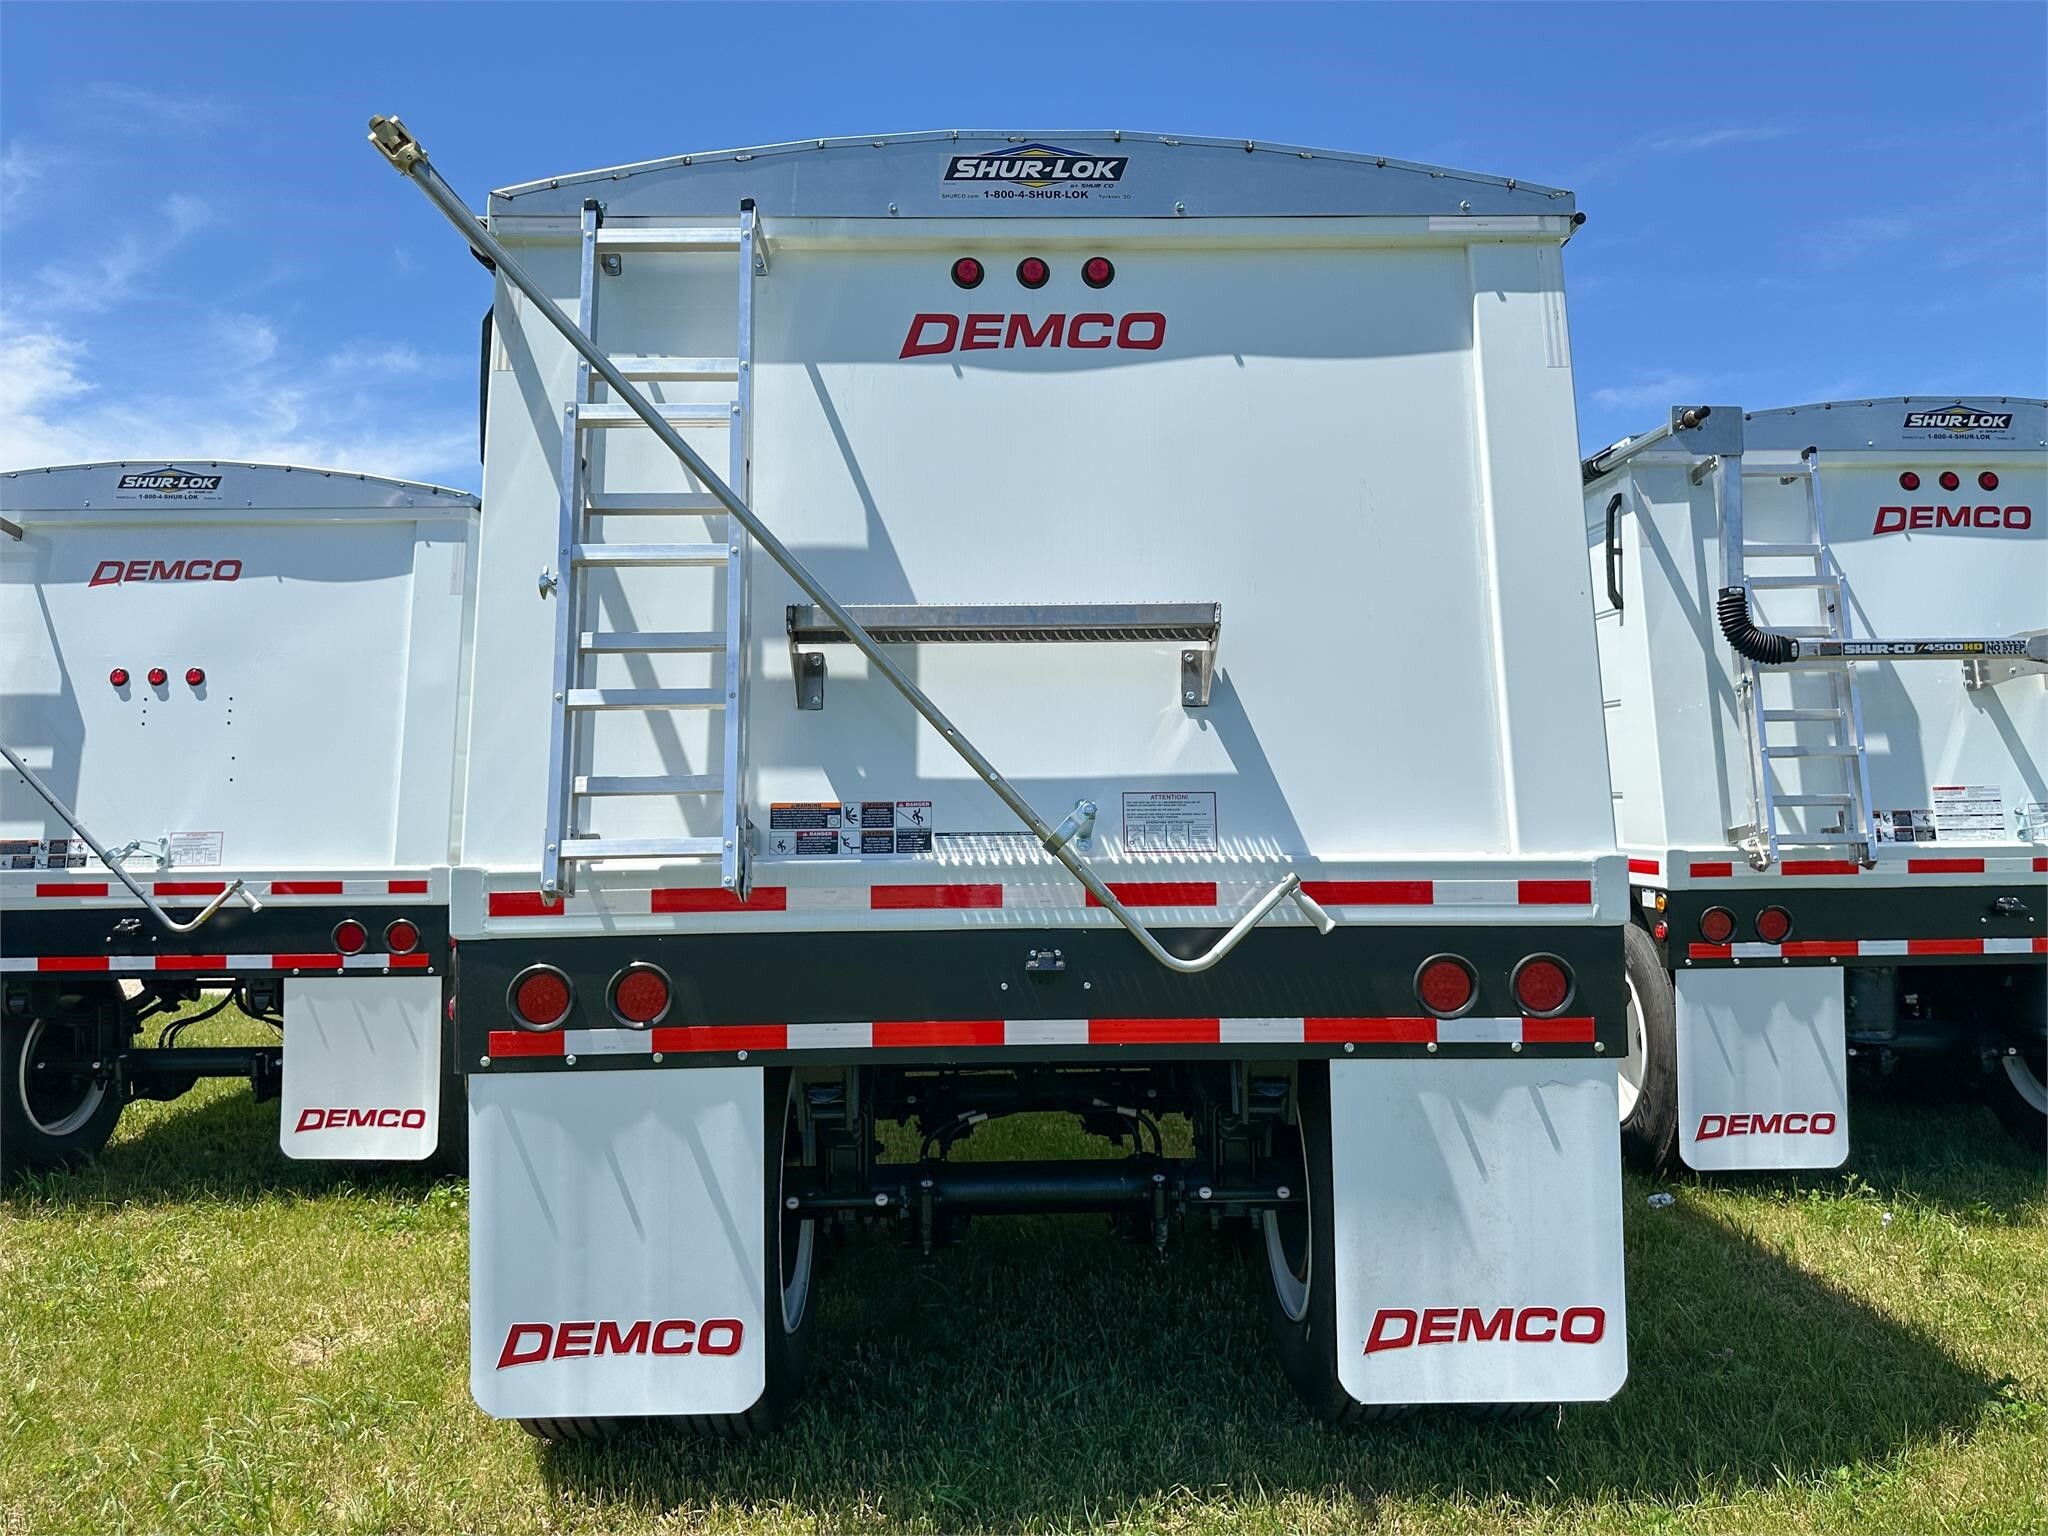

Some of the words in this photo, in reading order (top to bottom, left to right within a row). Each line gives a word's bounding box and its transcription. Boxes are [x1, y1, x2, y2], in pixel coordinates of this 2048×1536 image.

[953, 159, 1119, 179] SHUR-LOK
[983, 190, 1089, 199] 1-800-4-SHUR-LOK
[899, 312, 1167, 359] DEMCO
[1908, 414, 2008, 427] SHUR-LOK
[122, 476, 217, 488] SHUR-LOK
[1873, 506, 2032, 535] DEMCO
[88, 560, 243, 588] DEMCO
[1844, 643, 1915, 654] SHUR-CO
[1924, 643, 1983, 651] 4500HD
[295, 1109, 426, 1133] DEMCO
[1695, 1113, 1836, 1142] DEMCO
[496, 1318, 744, 1370] DEMCO
[1363, 1307, 1606, 1355] DEMCO
